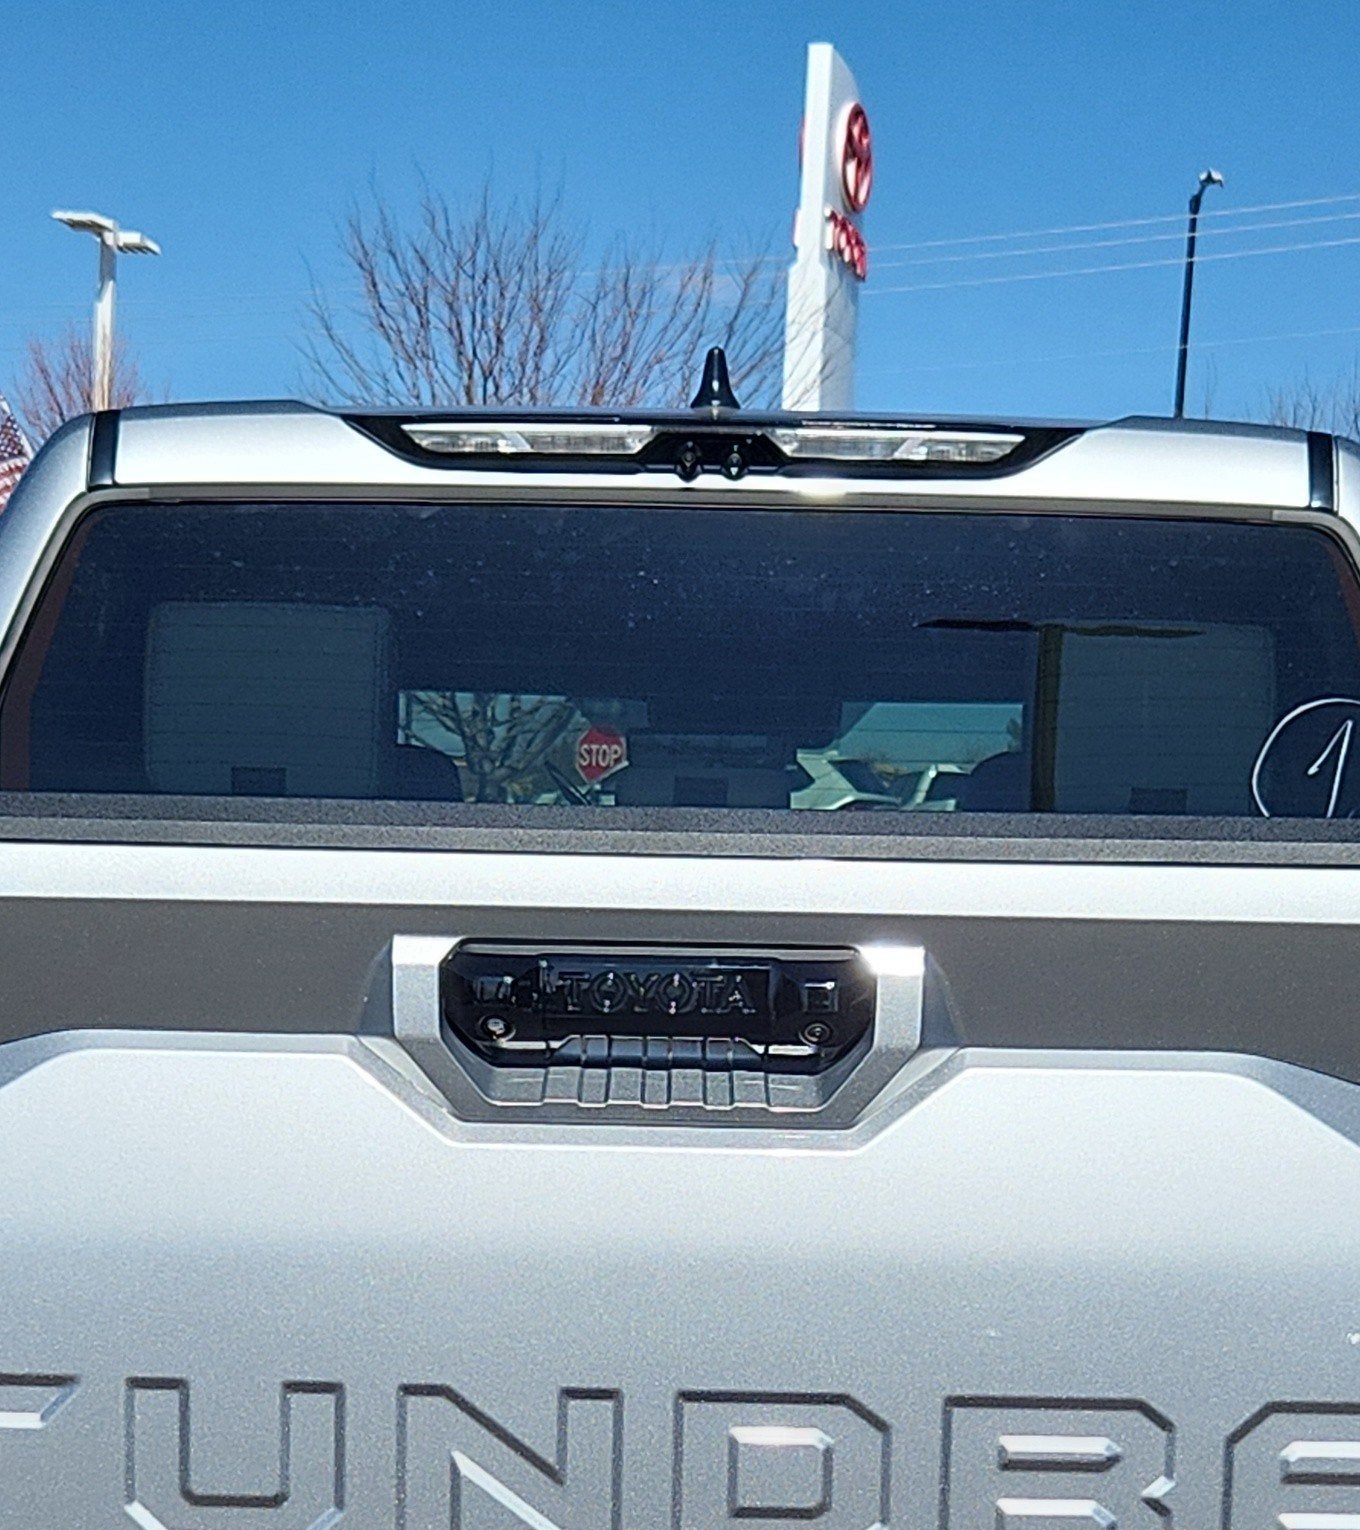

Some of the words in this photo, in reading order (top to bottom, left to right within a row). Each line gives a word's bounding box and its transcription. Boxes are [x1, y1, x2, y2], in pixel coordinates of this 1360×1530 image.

[580, 744, 622, 767] STOP
[1307, 719, 1353, 818] 1
[558, 970, 756, 1015] TOYOTA
